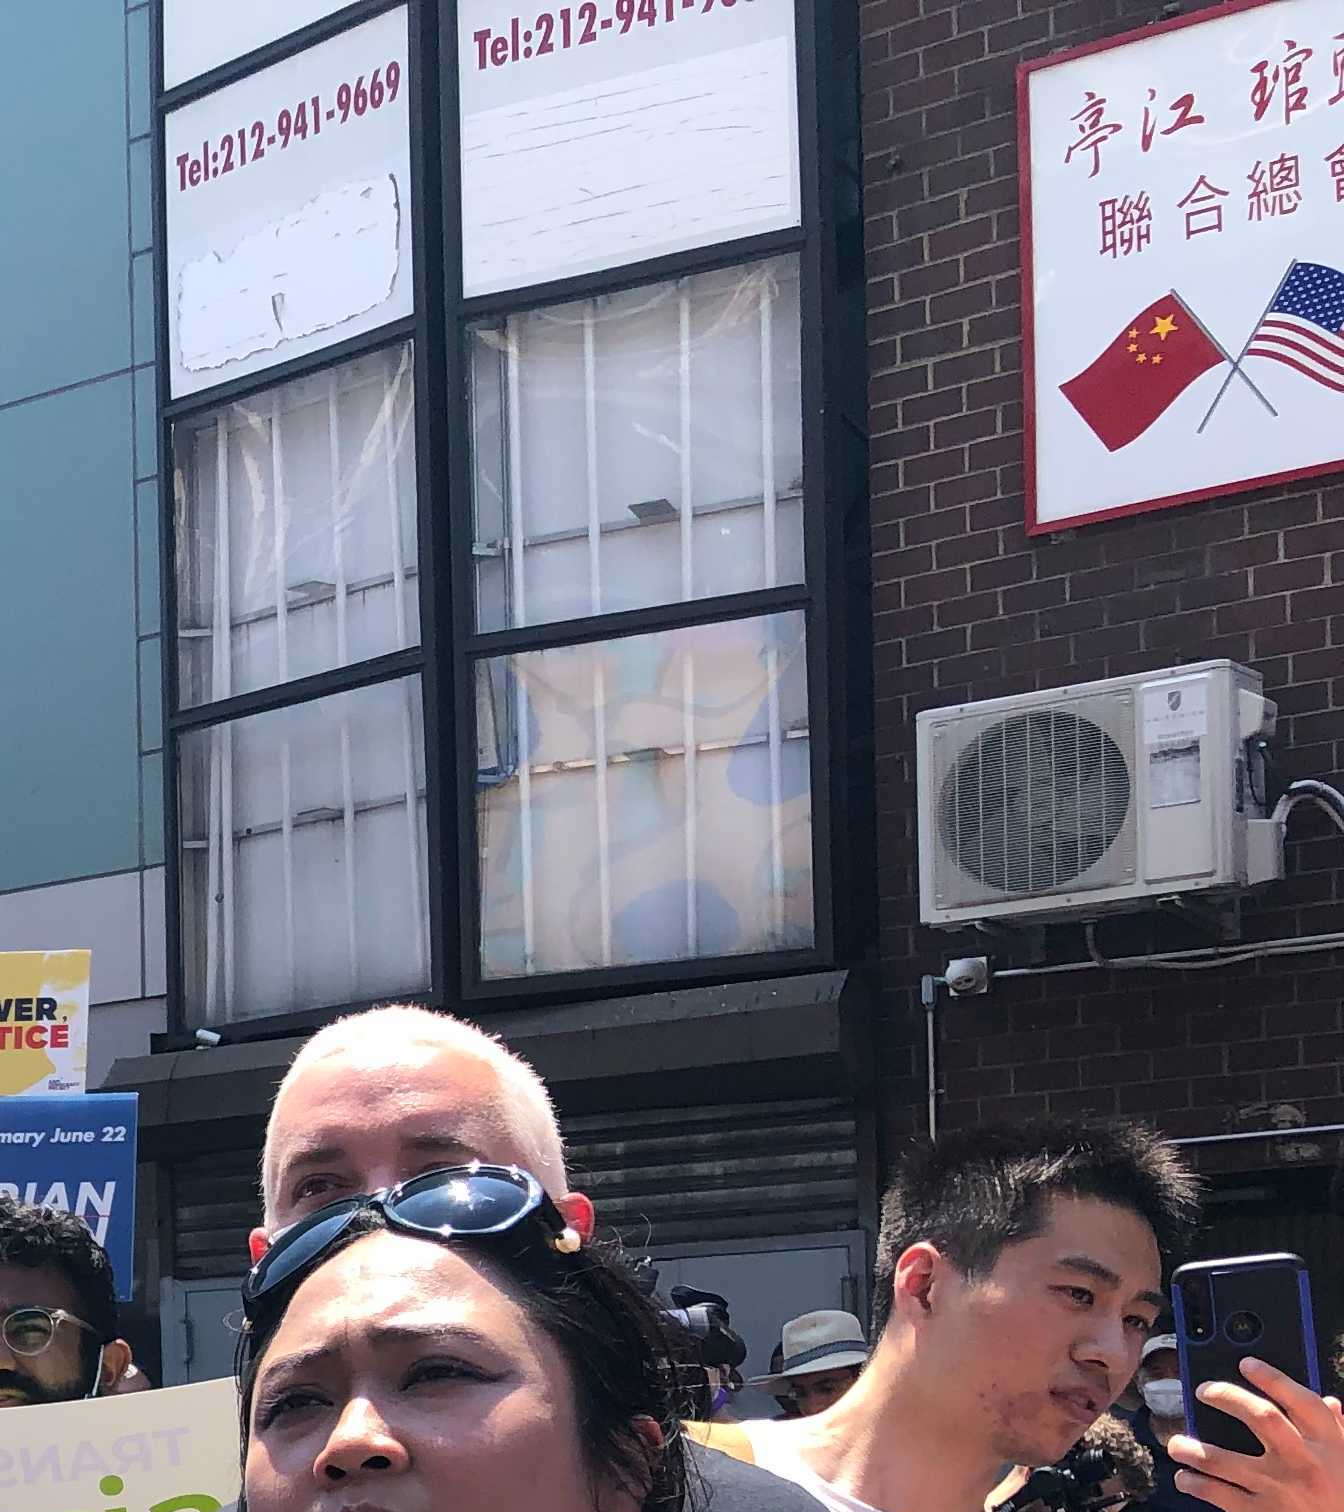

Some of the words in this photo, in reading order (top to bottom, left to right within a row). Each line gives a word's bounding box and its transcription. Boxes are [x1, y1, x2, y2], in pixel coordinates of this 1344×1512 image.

[175, 60, 402, 192] Tel:212-941-9669
[50, 1128, 95, 1143] June
[101, 1127, 127, 1142] 22
